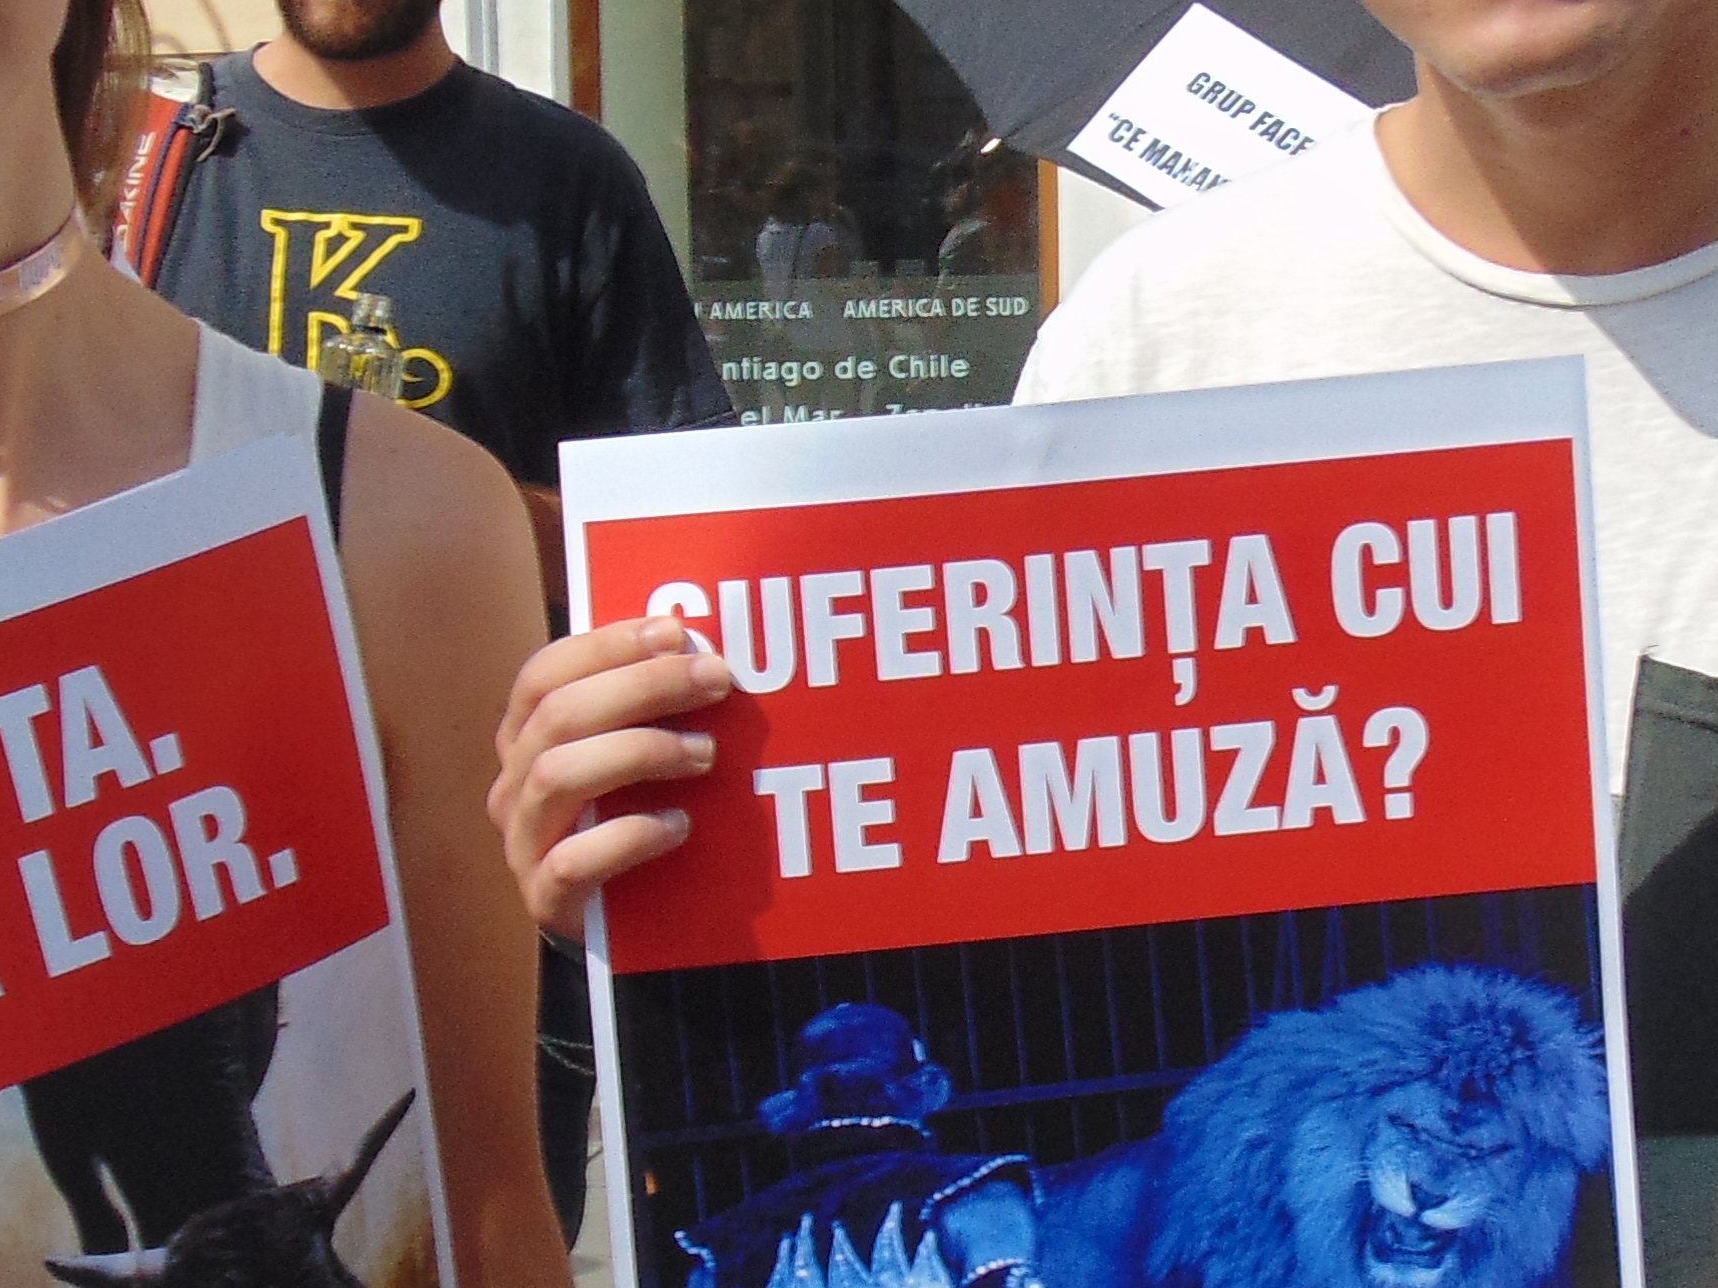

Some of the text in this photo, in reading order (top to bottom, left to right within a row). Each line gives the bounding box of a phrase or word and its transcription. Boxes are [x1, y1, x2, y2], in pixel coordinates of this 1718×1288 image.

[1185, 72, 1256, 118] GRUP
[709, 301, 814, 320] AMERICA
[843, 298, 946, 318] AMERICA
[951, 298, 980, 317] DE
[985, 297, 1030, 316] SUD
[835, 356, 877, 380] de
[889, 355, 971, 379] Chile
[1331, 512, 1523, 640] CUI
[753, 685, 1430, 881] TE AMUZĂ?
[16, 784, 301, 980] LOR.
